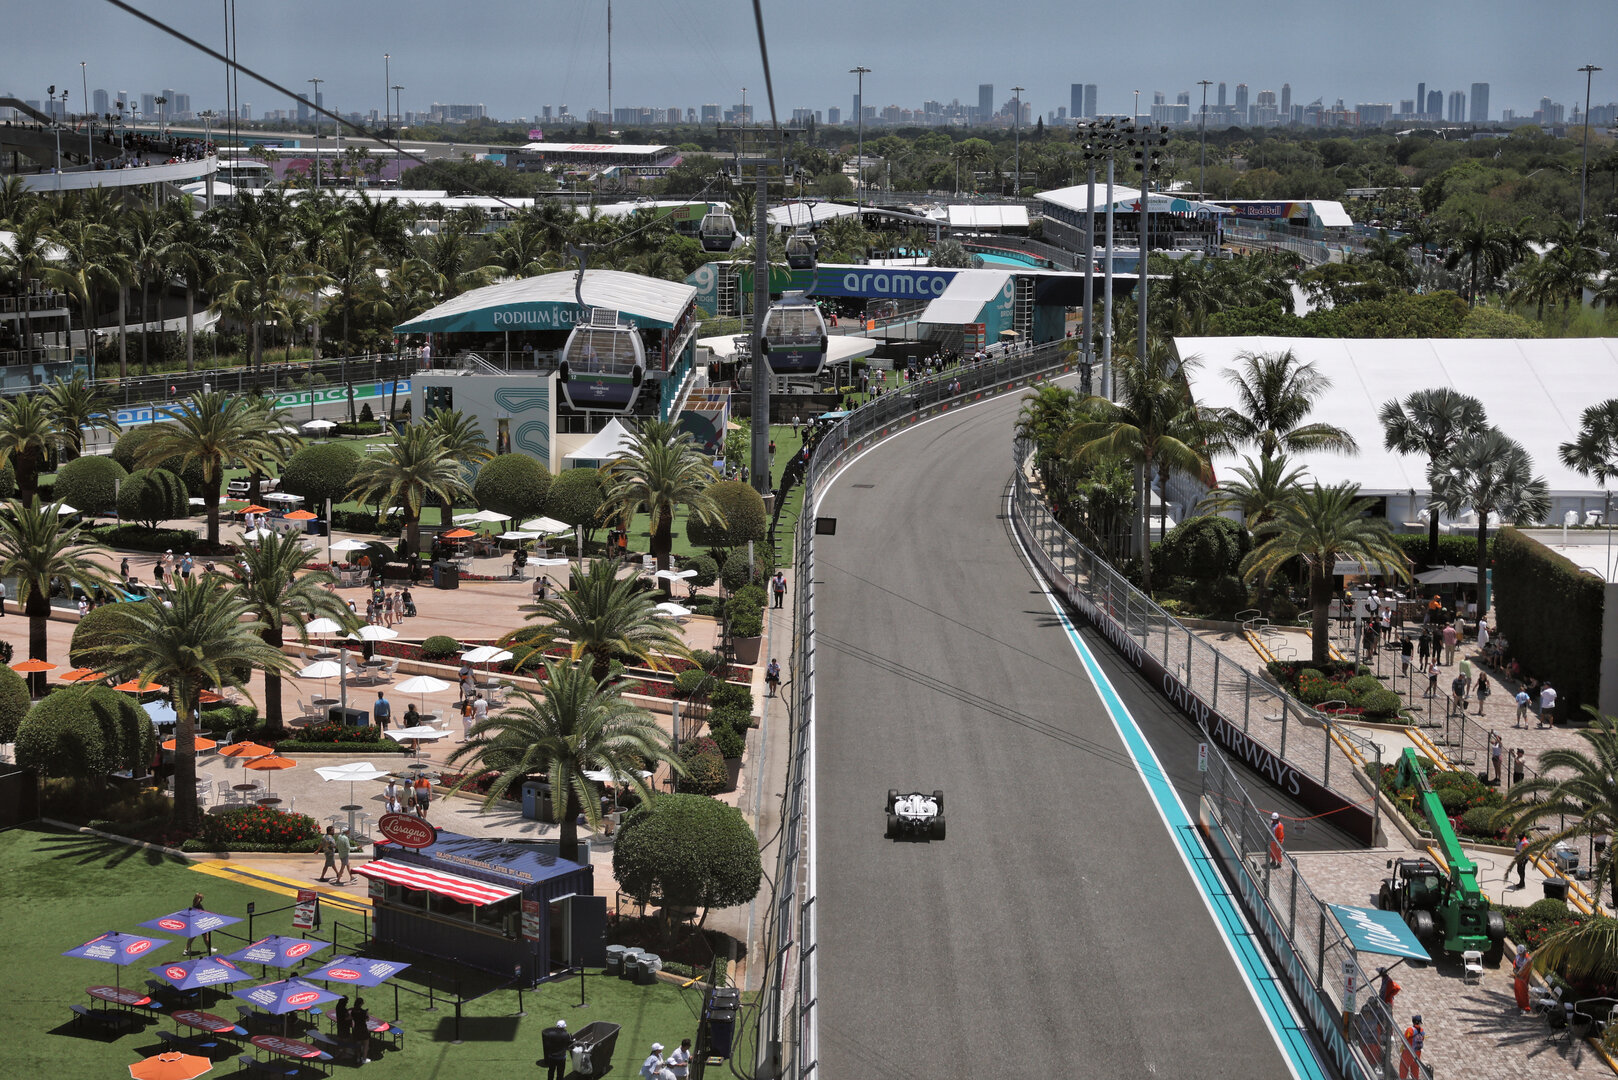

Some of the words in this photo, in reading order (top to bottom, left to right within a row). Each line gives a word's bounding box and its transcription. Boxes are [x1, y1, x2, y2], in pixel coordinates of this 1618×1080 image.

[1248, 206, 1264, 215] Red
[1265, 206, 1281, 215] Bull
[695, 266, 714, 295] 9
[843, 273, 947, 295] aramco
[1003, 278, 1015, 308] 9
[493, 311, 551, 325] PODIUM
[1099, 617, 1143, 668] AIRWAYS
[1163, 673, 1210, 733] QATAR
[1214, 718, 1301, 796] AIRWAYS
[384, 819, 427, 839] Lasagna
[1467, 898, 1478, 906] 12
[1239, 868, 1284, 969] QATAR
